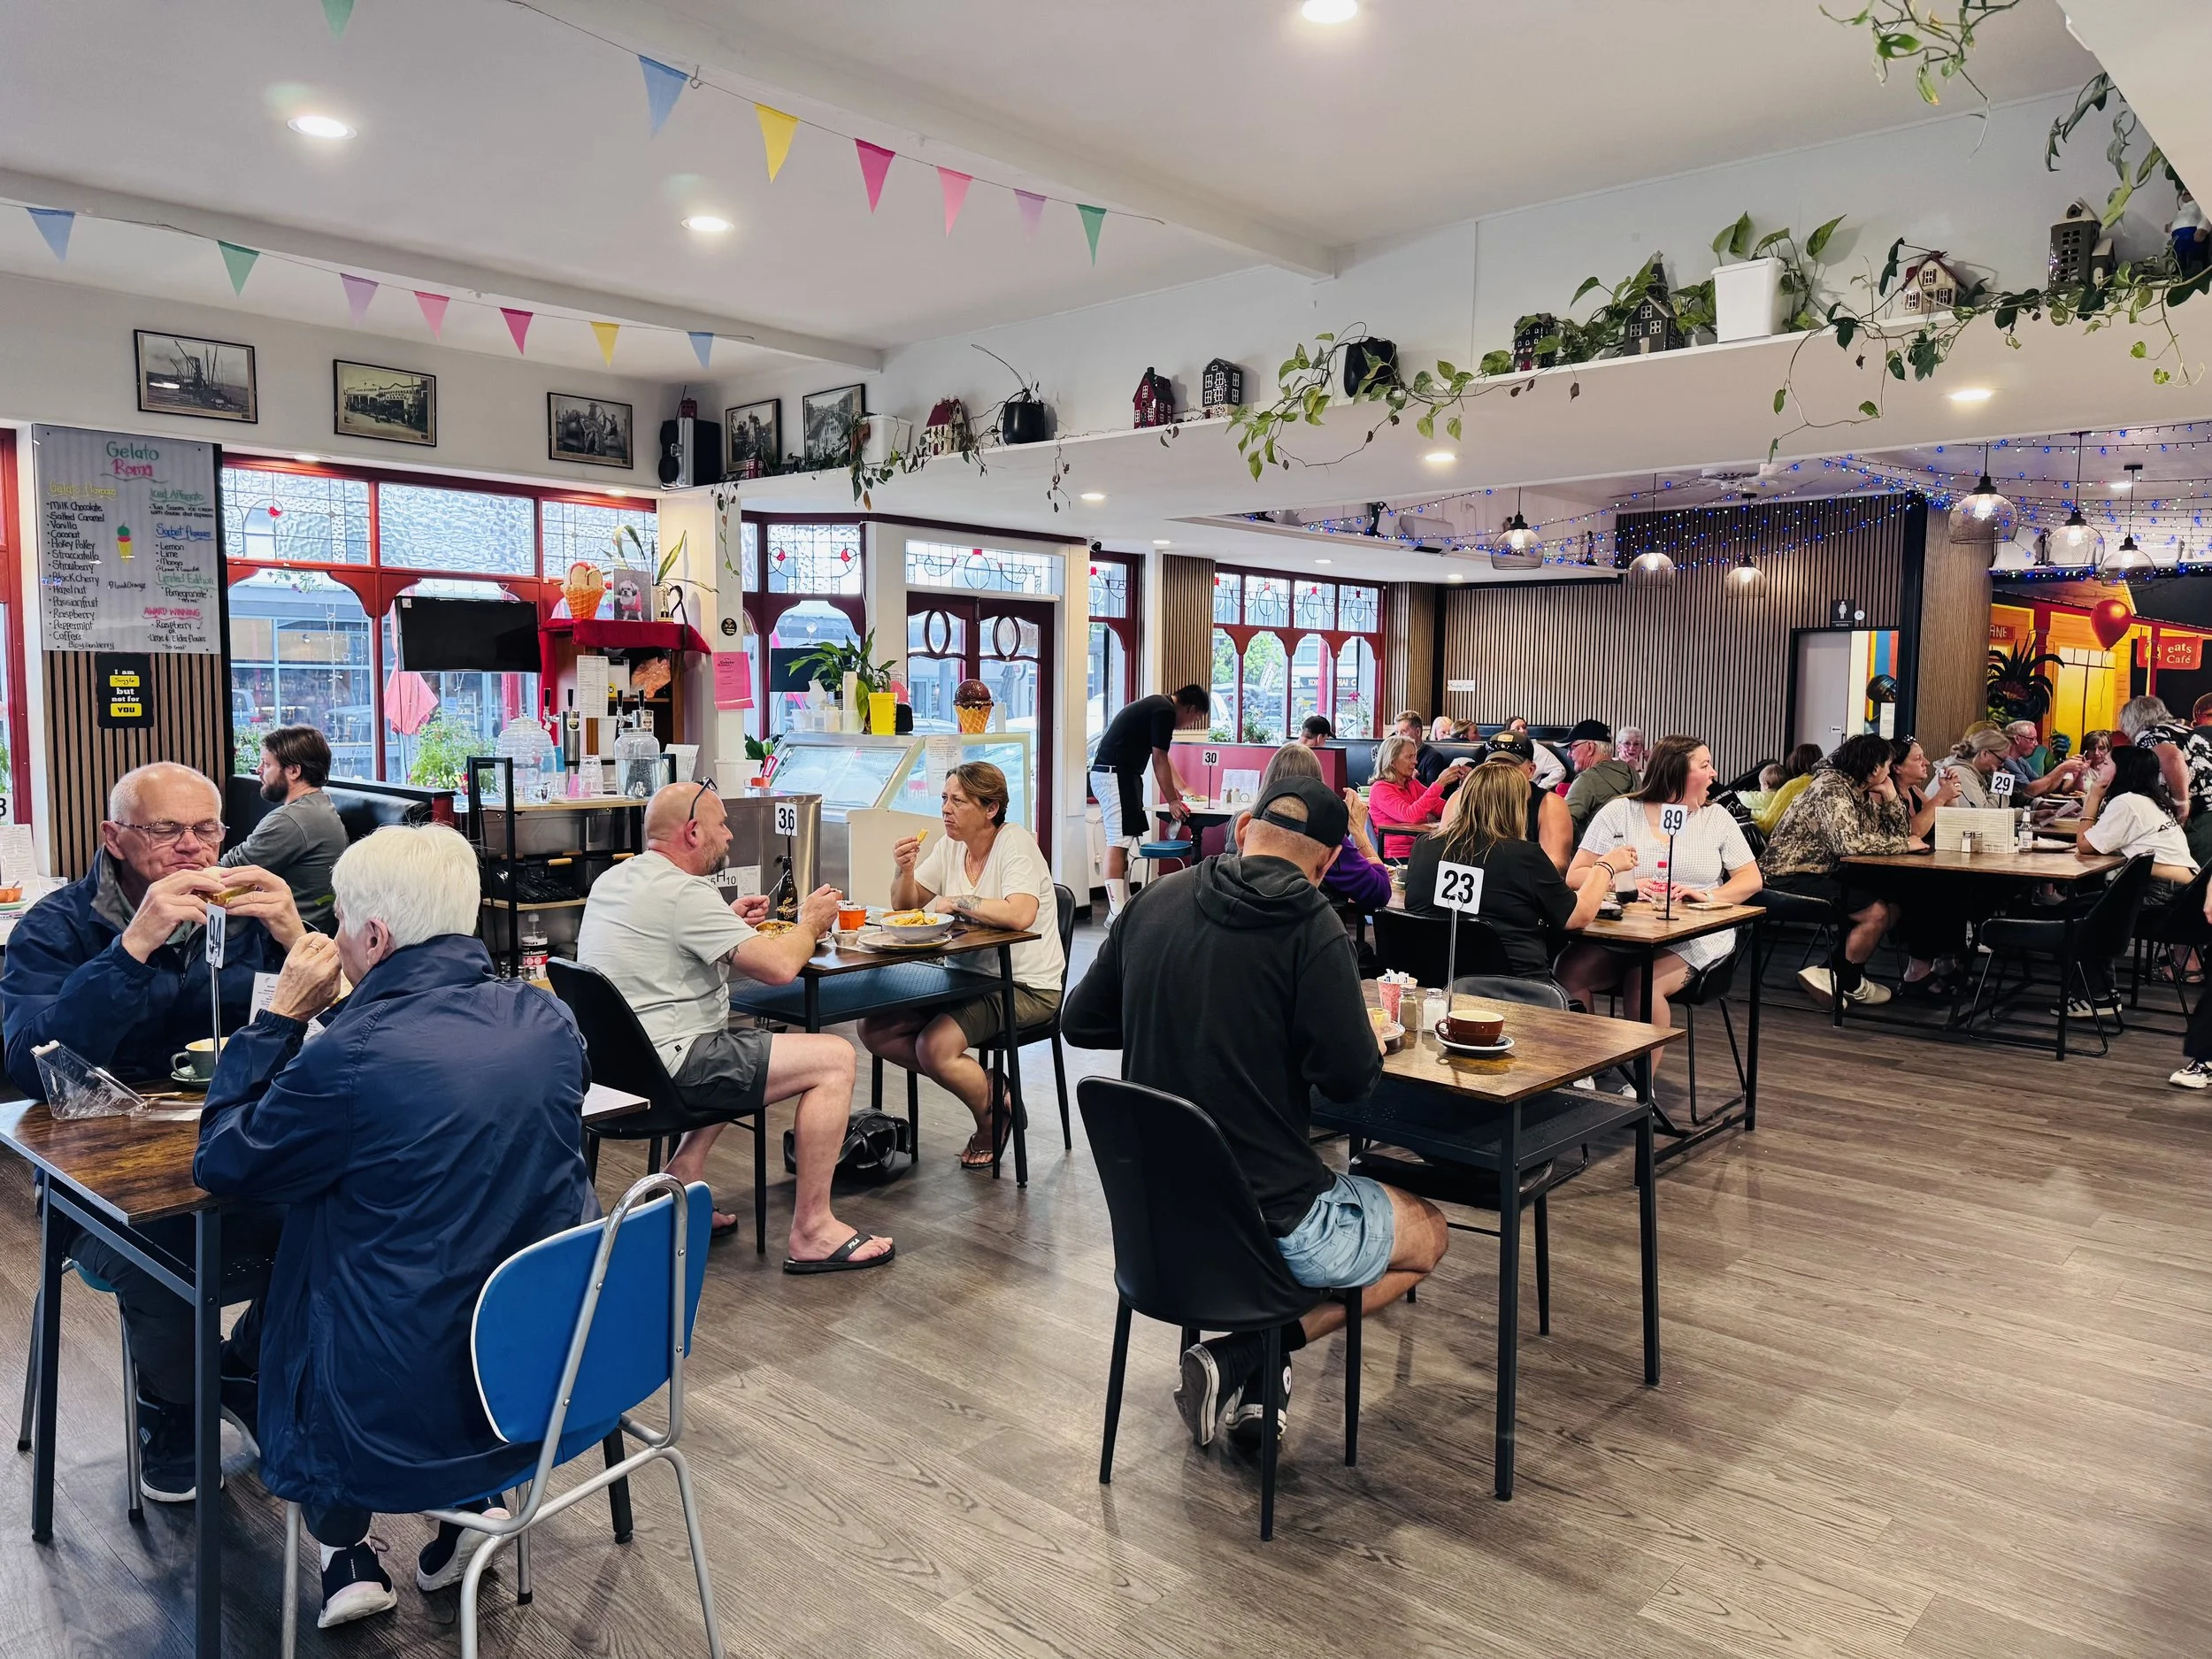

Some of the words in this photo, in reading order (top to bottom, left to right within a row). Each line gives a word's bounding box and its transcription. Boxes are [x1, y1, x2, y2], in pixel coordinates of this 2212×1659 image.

[106, 442, 159, 460] Gelato
[111, 458, 153, 477] Roma
[71, 502, 104, 512] Chocolate
[50, 511, 75, 521] Salted
[78, 513, 105, 522] Caramel
[50, 520, 77, 530] Vanilla
[156, 522, 184, 537] Sorbet
[50, 530, 81, 539] Coconut
[159, 541, 185, 550] Lemon
[52, 560, 94, 573] Strawberry
[159, 558, 184, 569] Mango
[157, 572, 185, 584] Limited
[187, 573, 214, 585] Edition
[52, 584, 87, 595] Hazelnut
[53, 595, 98, 609] Passionfruit
[53, 607, 95, 621] Raspberry
[143, 606, 167, 616] AWARD
[169, 608, 201, 618] WINNING
[53, 619, 94, 631] Peppermint
[156, 619, 192, 630] Raspberry
[1989, 624, 2008, 638] ANE
[53, 631, 82, 641] Coffee
[2168, 643, 2193, 654] eats
[2166, 655, 2192, 664] Café
[1204, 751, 1217, 764] 30
[1993, 776, 2011, 791] 29
[779, 807, 795, 830] 36
[1663, 810, 1683, 830] 89
[1440, 870, 1475, 904] 23
[209, 914, 222, 957] 94
